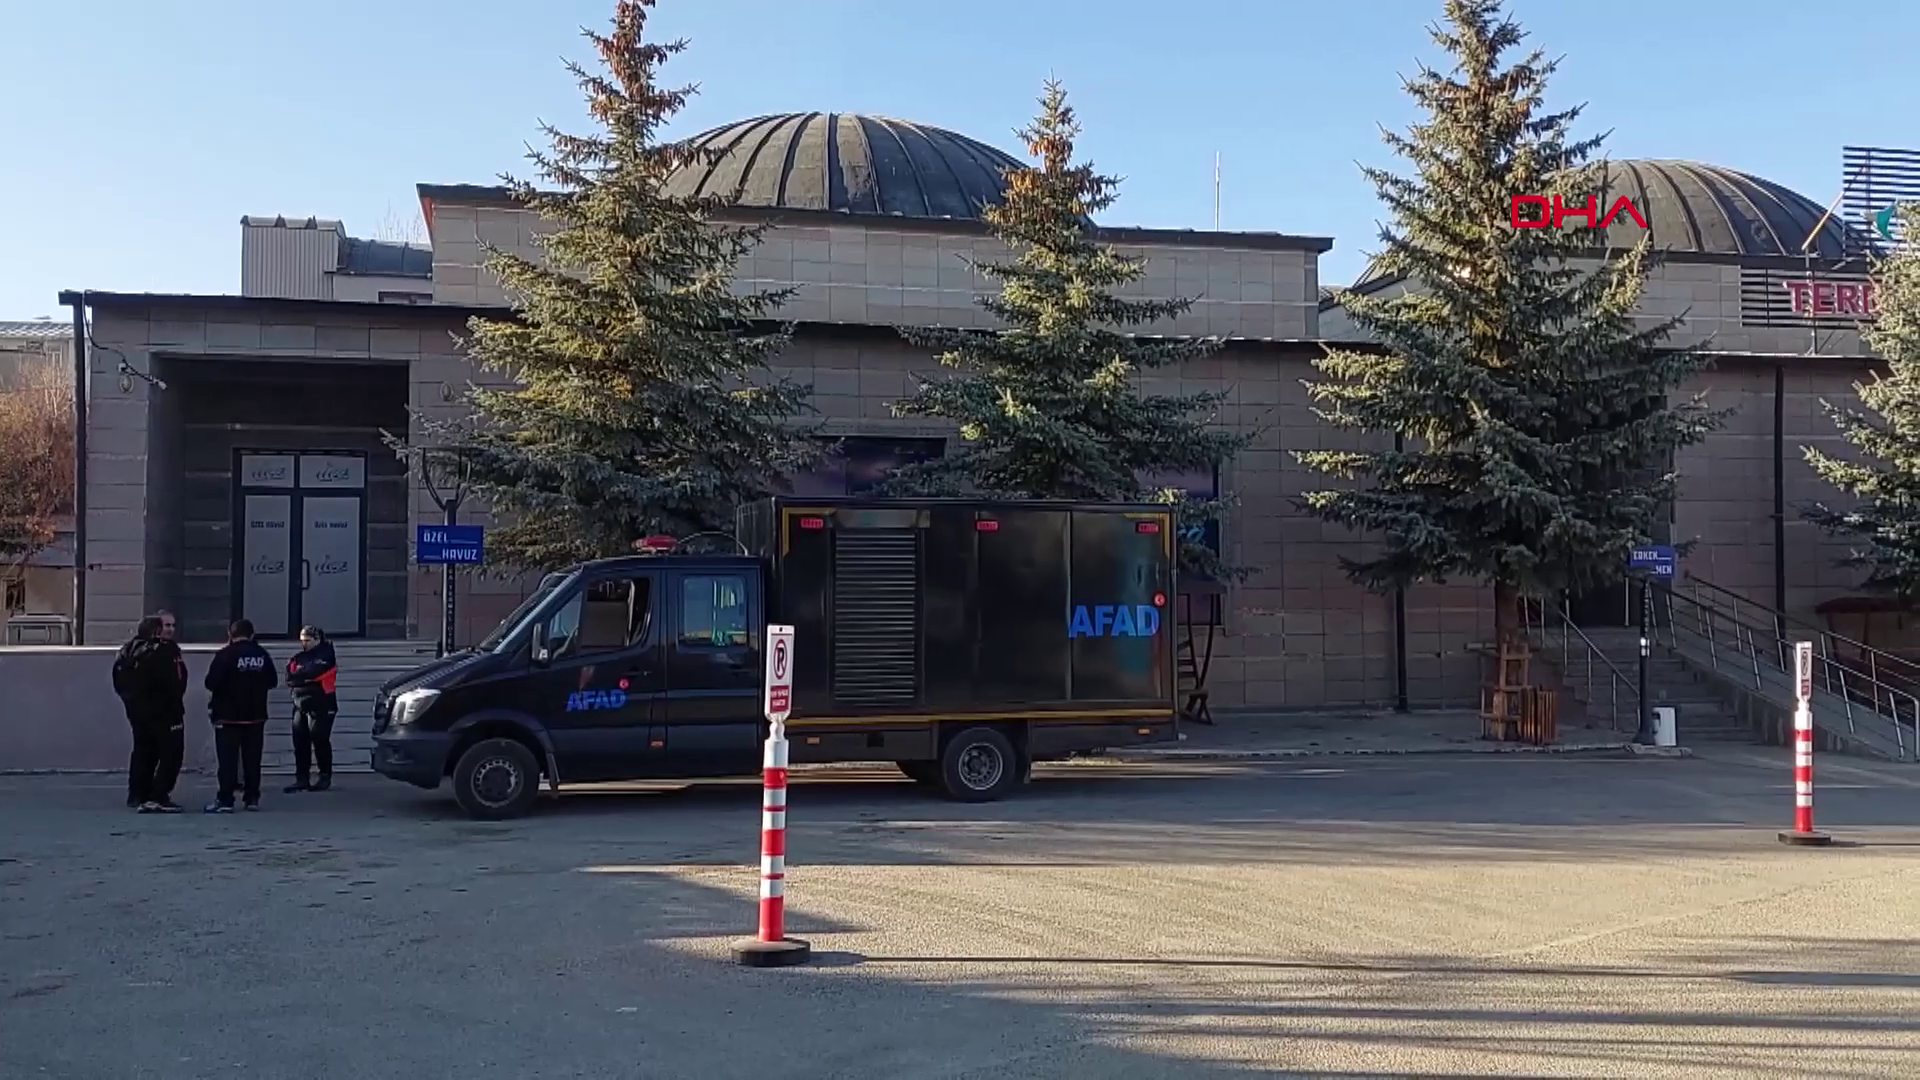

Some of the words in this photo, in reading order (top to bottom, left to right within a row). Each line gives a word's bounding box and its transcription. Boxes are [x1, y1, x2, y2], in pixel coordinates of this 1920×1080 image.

[423, 529, 448, 543] ÖZEL
[442, 548, 477, 560] HAVUZ
[1068, 605, 1161, 638] AFAD
[237, 657, 264, 668] AFAD
[566, 689, 626, 711] AFAD
